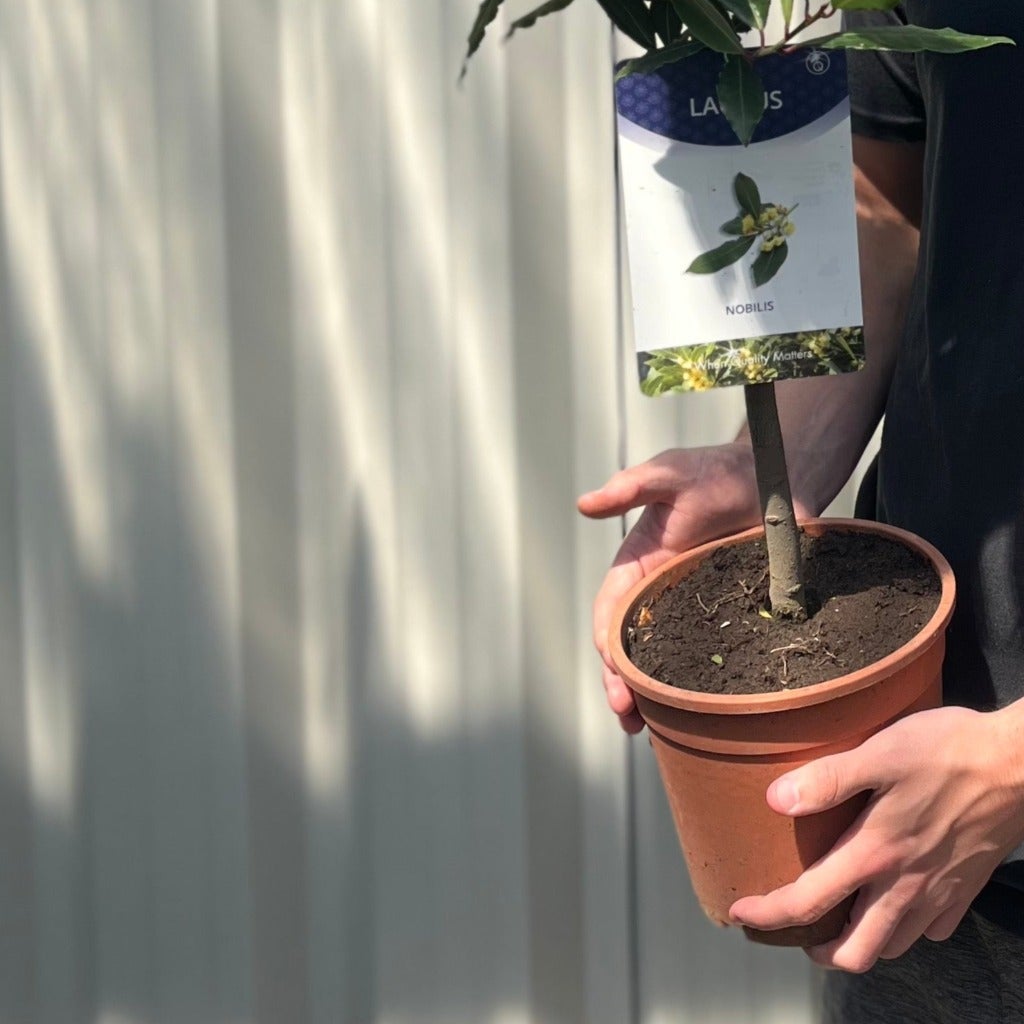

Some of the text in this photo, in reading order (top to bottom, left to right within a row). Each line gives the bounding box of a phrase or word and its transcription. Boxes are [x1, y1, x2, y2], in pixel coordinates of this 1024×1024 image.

[690, 90, 783, 117] LAS
[725, 300, 775, 316] NOBILIS
[773, 350, 813, 363] Matters
